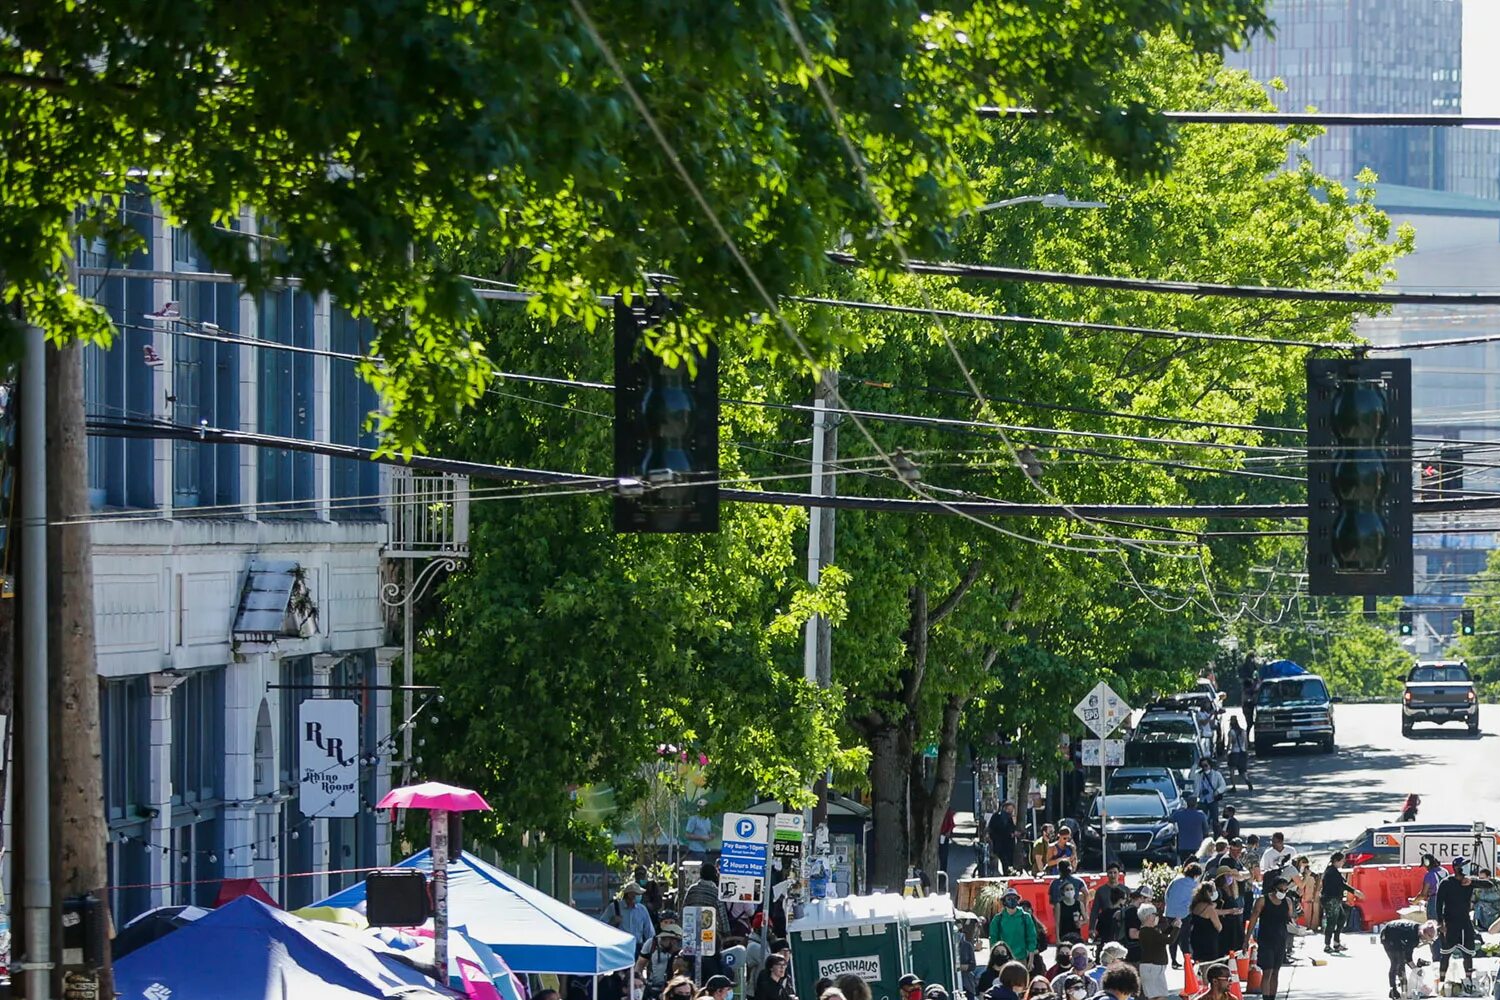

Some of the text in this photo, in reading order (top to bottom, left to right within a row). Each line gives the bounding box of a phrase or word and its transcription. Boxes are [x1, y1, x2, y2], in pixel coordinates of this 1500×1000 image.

[774, 844, 800, 853] 87431
[722, 858, 729, 868] 2
[821, 959, 878, 977] GREENHAUS
